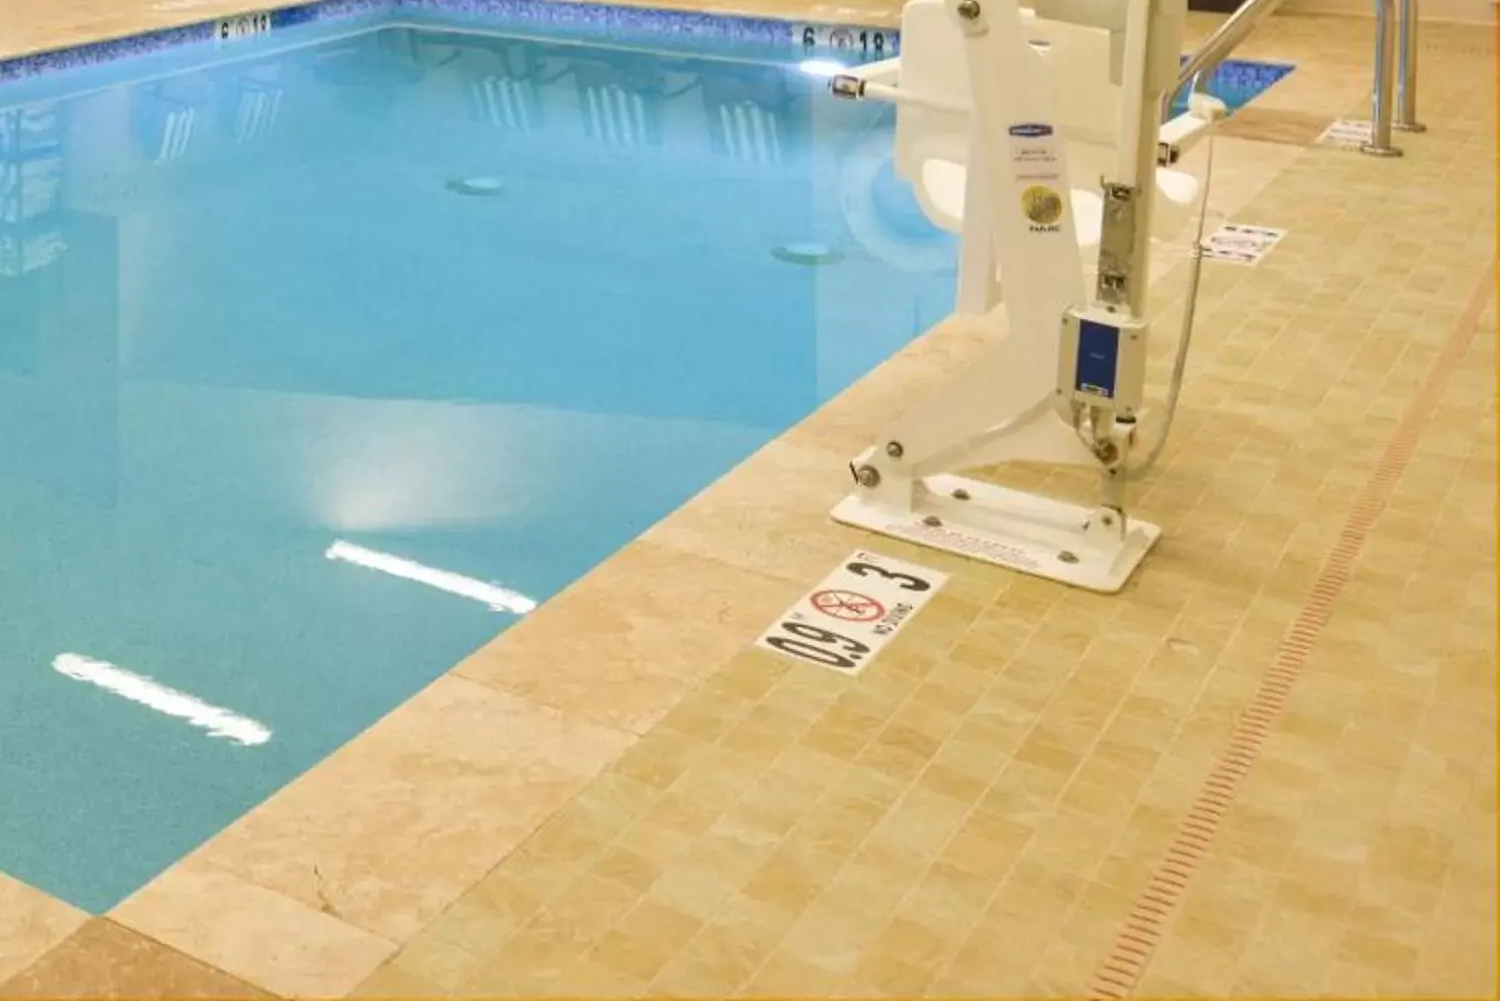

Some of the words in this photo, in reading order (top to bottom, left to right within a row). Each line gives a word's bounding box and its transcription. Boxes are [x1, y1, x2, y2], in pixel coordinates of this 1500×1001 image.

[803, 27, 815, 46] 6
[765, 621, 871, 668] 0.9
[845, 561, 931, 592] 3
